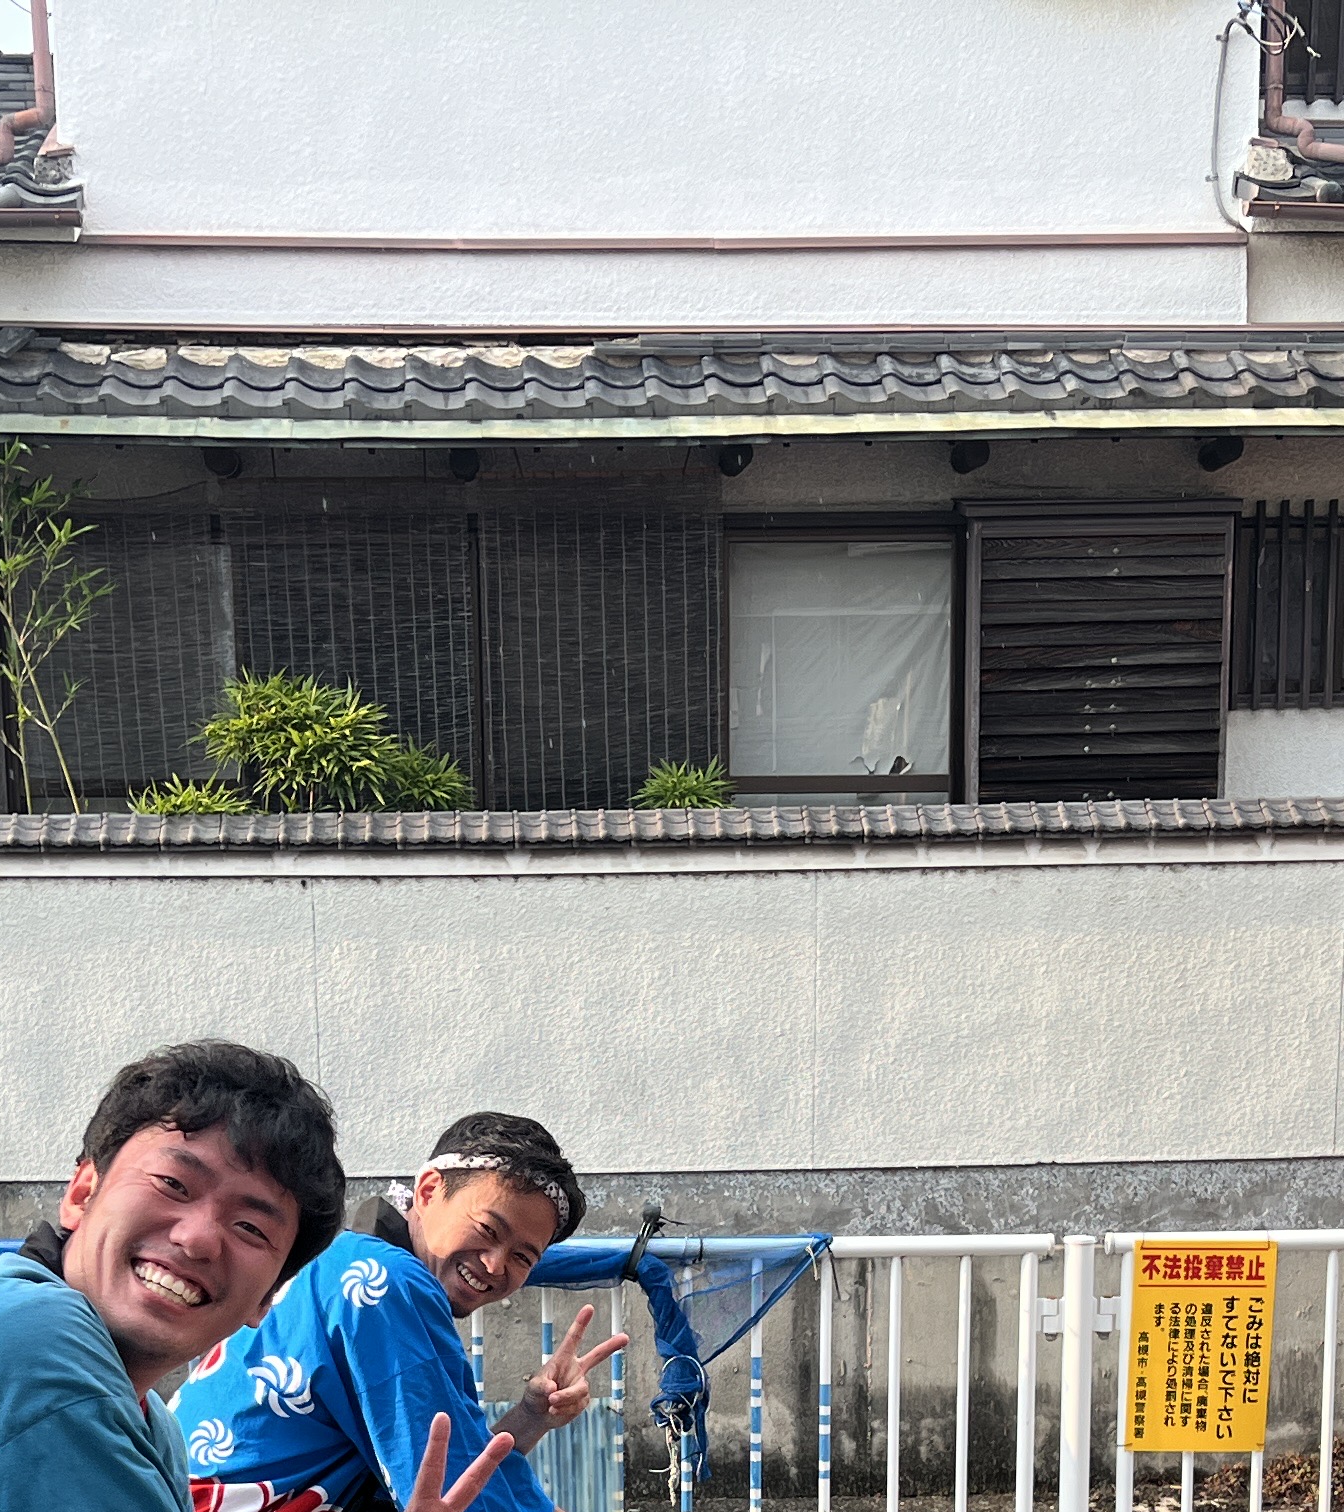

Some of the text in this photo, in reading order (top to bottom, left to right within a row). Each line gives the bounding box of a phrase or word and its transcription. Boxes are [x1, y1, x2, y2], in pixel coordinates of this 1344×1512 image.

[1142, 1254, 1265, 1281] 不法投棄禁止
[1164, 1302, 1181, 1427] る法律により処罰され
[1179, 1303, 1197, 1427] の処理及び清掃に関す
[1216, 1295, 1240, 1439] すてないで下さい
[1242, 1297, 1265, 1404] ごみは絶対に
